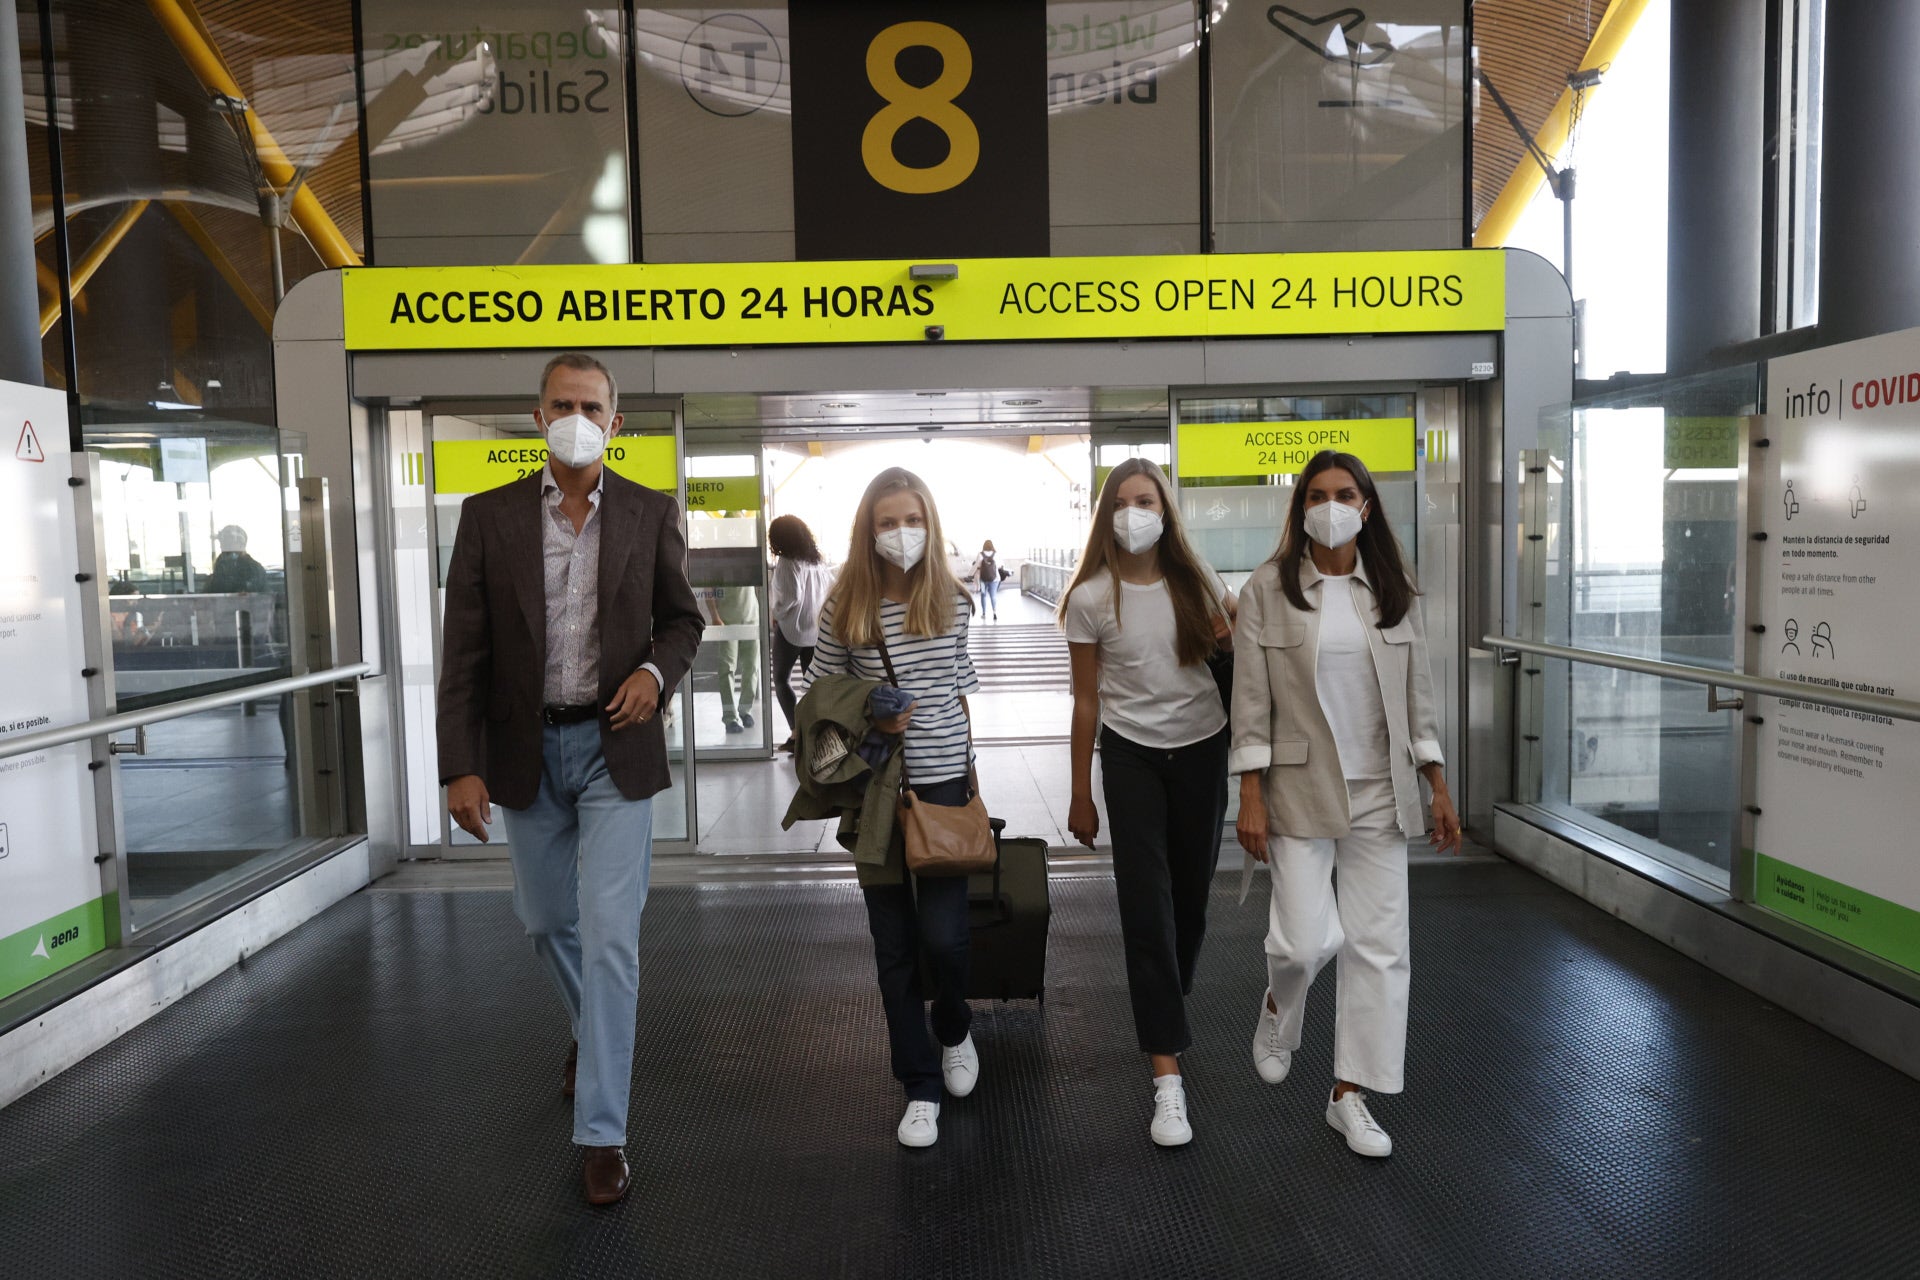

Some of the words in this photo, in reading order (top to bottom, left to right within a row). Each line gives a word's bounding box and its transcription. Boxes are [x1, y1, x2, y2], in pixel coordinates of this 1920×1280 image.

[862, 21, 980, 194] 8
[390, 290, 543, 324] ACCESO
[557, 288, 725, 321] ABIERTO
[740, 287, 788, 319] 24
[803, 284, 934, 318] HORAS
[999, 281, 1140, 315] ACCESS
[1155, 278, 1254, 311] OPEN
[1271, 277, 1317, 309] 24
[1334, 274, 1463, 308] HOURS
[1786, 383, 1830, 419] info
[1852, 372, 1920, 410] COVID
[1244, 431, 1303, 446] ACCESS
[1308, 430, 1350, 444] OPEN
[487, 449, 549, 463] ACCESO
[1258, 451, 1277, 465] 24
[1284, 449, 1317, 464] HOU
[686, 482, 724, 492] BIERTO
[686, 496, 705, 505] RAS
[1782, 535, 1805, 544] Mantén
[1806, 535, 1812, 544] la
[1813, 535, 1843, 544] distancia
[1844, 534, 1853, 544] de
[1854, 534, 1890, 546] seguridad
[1791, 549, 1805, 557] todo
[1806, 550, 1839, 558] momento.
[1782, 572, 1796, 582] Keep
[1802, 573, 1814, 581] safe
[1815, 572, 1841, 582] distance
[1842, 574, 1857, 583] from
[1858, 574, 1876, 584] other
[1781, 586, 1800, 595] people
[1801, 587, 1807, 595] at
[1817, 587, 1834, 596] times.
[1779, 670, 1785, 679] El
[1786, 673, 1797, 681] uso
[1798, 673, 1806, 682] de
[1807, 675, 1839, 688] mascarilla
[1841, 681, 1854, 691] que
[1855, 682, 1875, 693] cubra
[1876, 686, 1895, 696] nariz
[17, 721, 25, 730] es
[26, 715, 51, 730] posible.
[1779, 698, 1800, 709] cumplir
[1802, 701, 1813, 710] con
[1814, 703, 1820, 712] la
[1821, 705, 1850, 718] etiqueta
[1851, 711, 1895, 726] respiratoria.
[1778, 723, 1789, 734] You
[1789, 727, 1804, 737] must
[1805, 731, 1819, 740] wear
[1826, 733, 1855, 747] facemask
[1855, 740, 1885, 756] covering
[1778, 738, 1790, 747] your
[1791, 740, 1805, 749] nose
[1806, 743, 1817, 753] and
[1840, 750, 1874, 765] Remember
[1875, 759, 1883, 768] to
[1777, 750, 1800, 761] observe
[1800, 756, 1832, 772] respiratory
[1833, 763, 1865, 779] etiquette.
[1816, 890, 1830, 903] Help
[1839, 899, 1847, 909] to
[1847, 903, 1862, 914] take
[1816, 903, 1828, 913] care
[1829, 907, 1836, 915] of
[1838, 911, 1848, 922] you
[51, 926, 79, 949] aena
